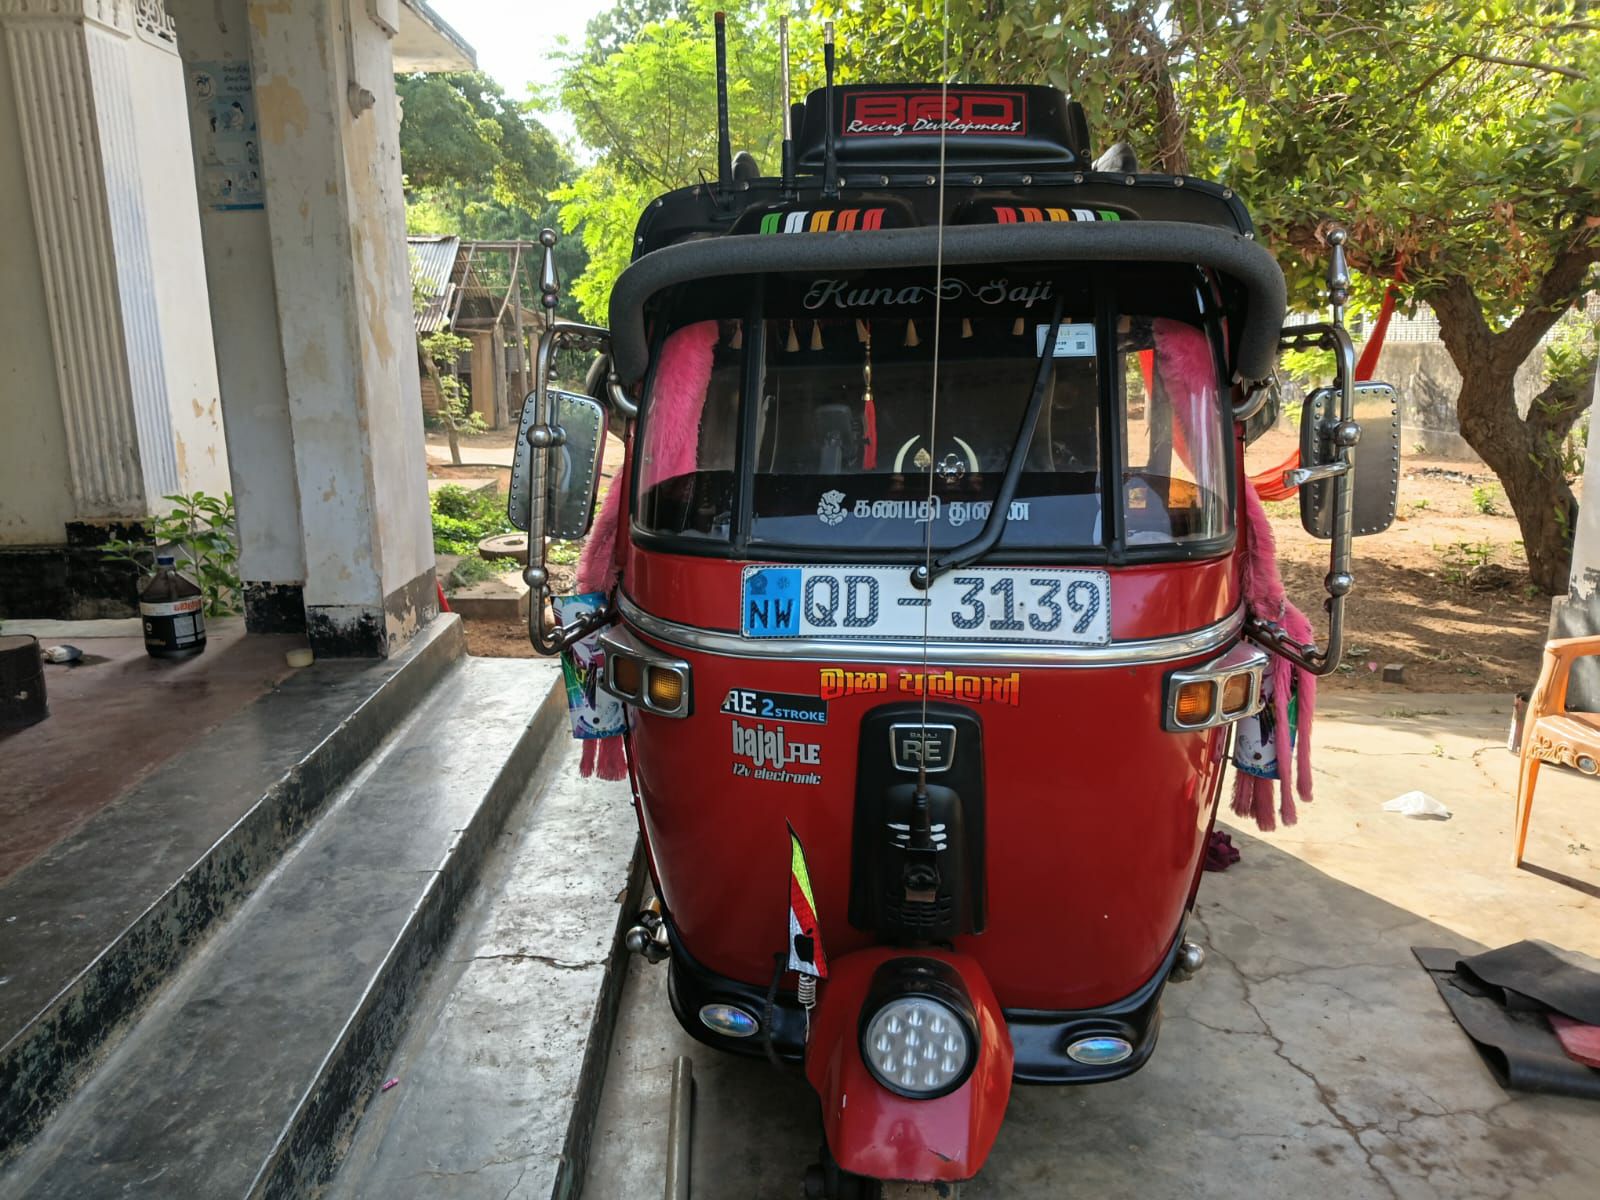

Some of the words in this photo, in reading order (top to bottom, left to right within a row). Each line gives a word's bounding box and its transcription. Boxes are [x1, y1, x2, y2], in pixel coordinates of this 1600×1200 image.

[855, 96, 1014, 125] BRD
[847, 119, 907, 136] Racing
[803, 279, 924, 310] Kuna
[978, 278, 1053, 308] Saji
[854, 495, 941, 524] கணபதி
[750, 598, 793, 629] NW
[804, 575, 880, 628] QD
[951, 577, 1101, 634] 3139
[761, 698, 775, 716] 2
[775, 708, 825, 722] STROKE
[732, 719, 784, 769] bajaj
[902, 740, 942, 761] RE
[754, 767, 821, 785] electronic
